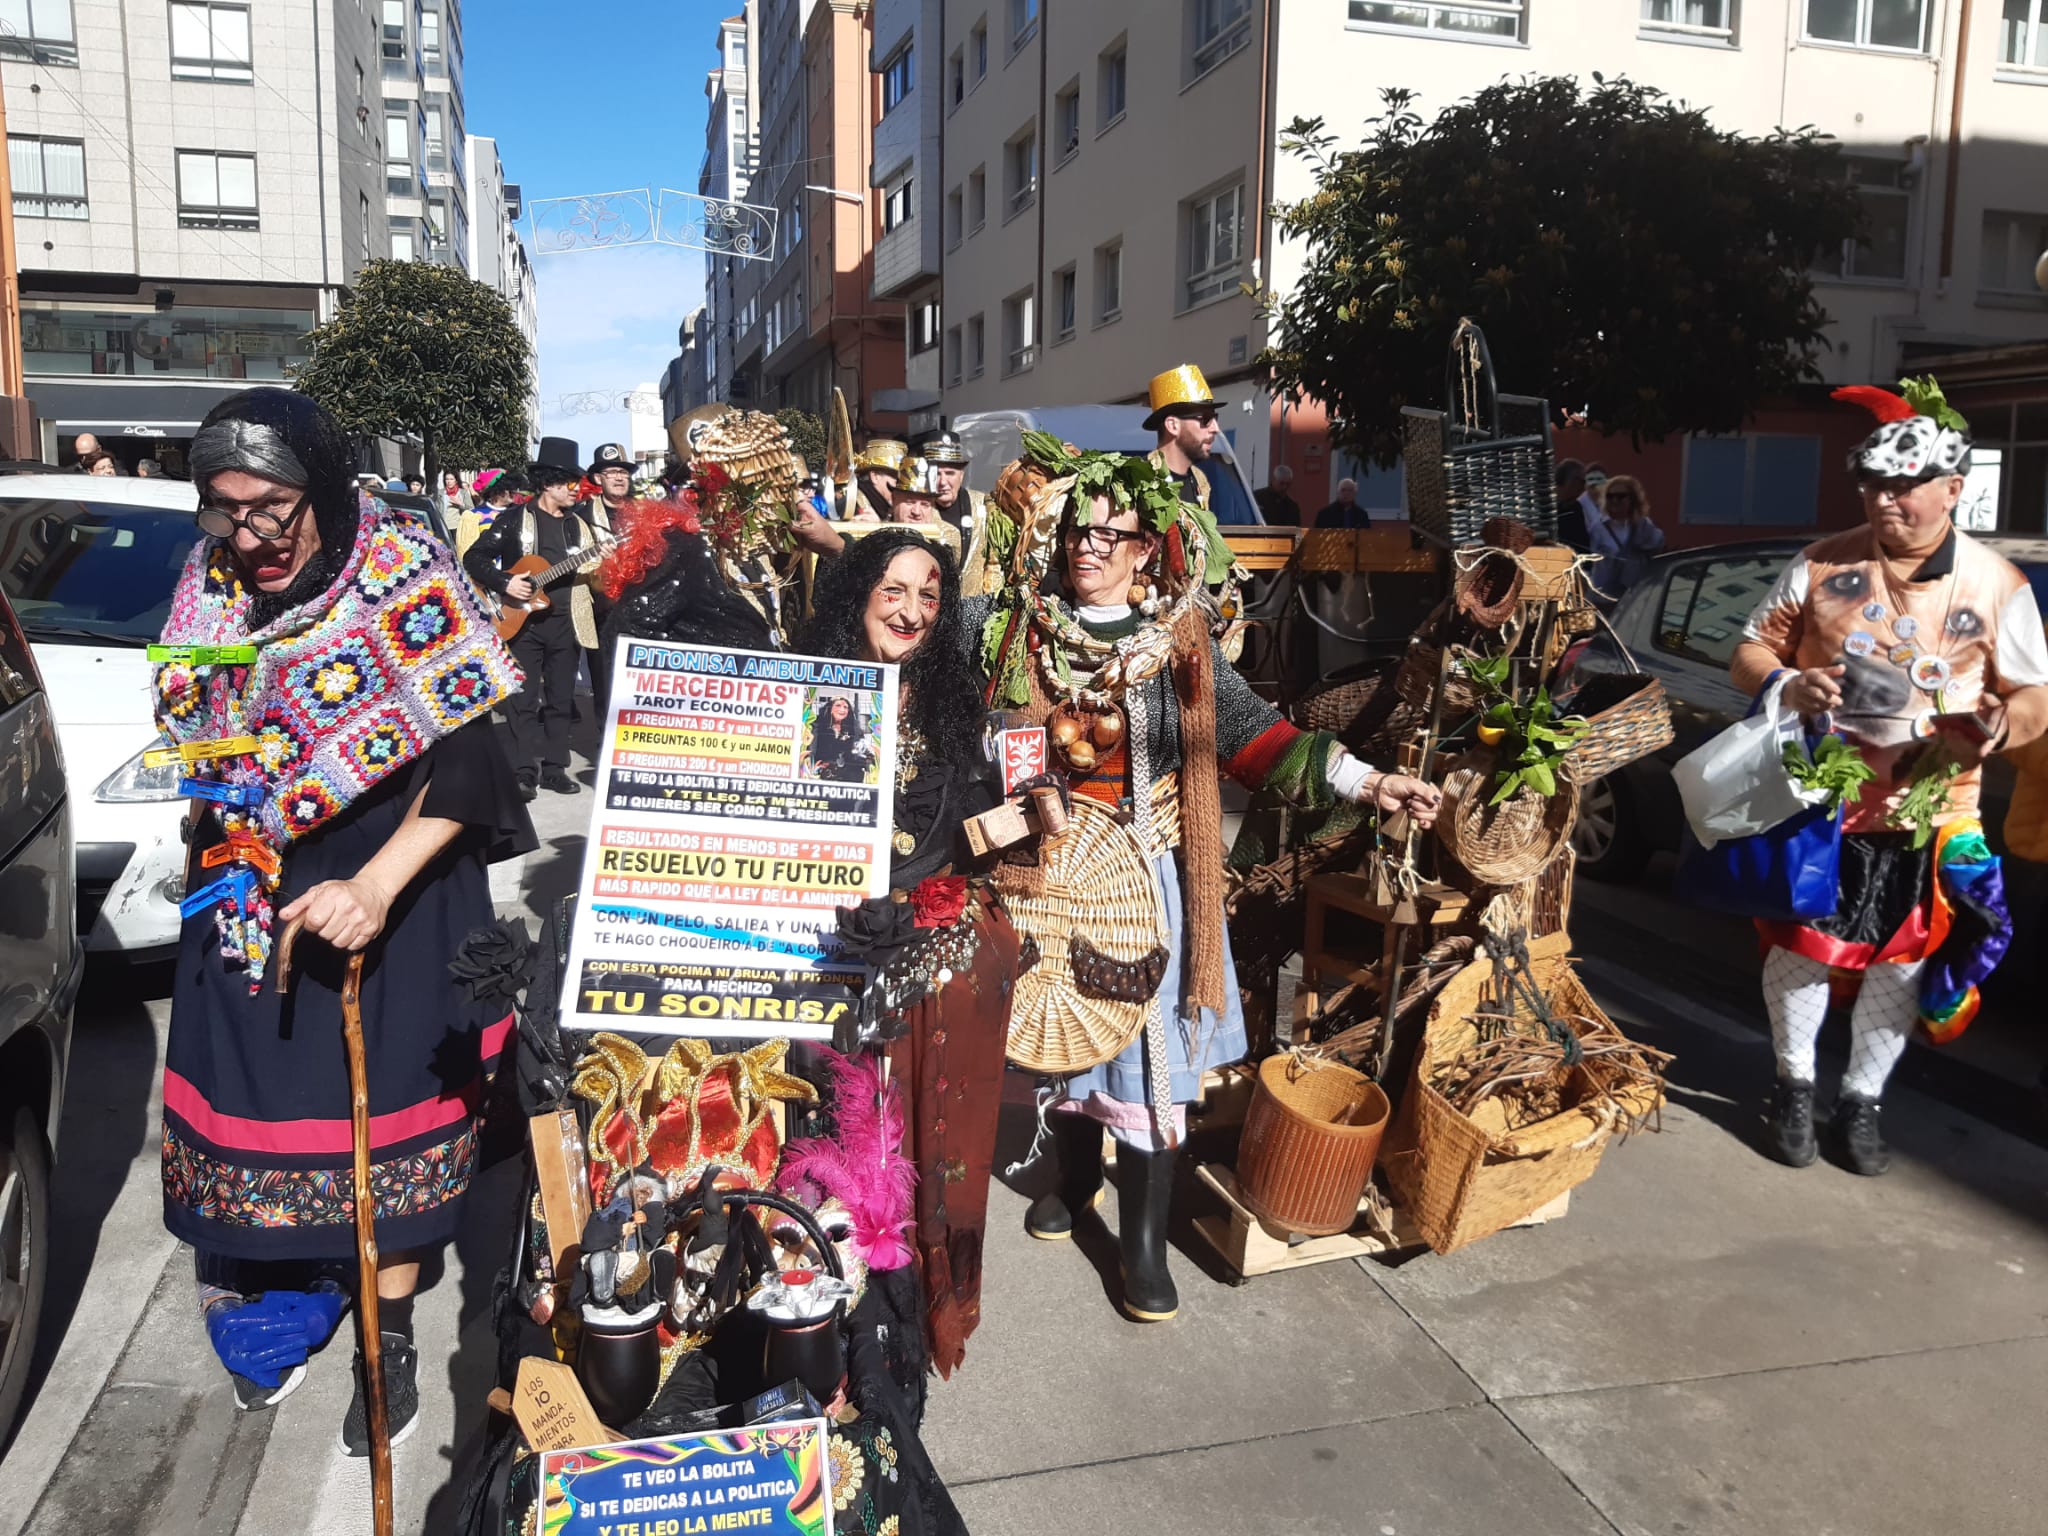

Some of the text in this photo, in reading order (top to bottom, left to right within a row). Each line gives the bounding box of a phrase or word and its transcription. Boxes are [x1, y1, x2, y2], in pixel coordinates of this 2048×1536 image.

[632, 646, 878, 687] PITONISA AMBULANTE
[626, 671, 799, 705] "MERCEDITAS"
[633, 695, 785, 719] TAROT ECONOMICO
[624, 713, 794, 739] 1 PREGUNTA 50 € y un LACON
[622, 731, 791, 756] 3 PREGUNTAS 100 € y un JAMON
[618, 752, 626, 764] 5
[628, 753, 687, 768] PREGUNTAS
[688, 758, 707, 771] 200
[717, 763, 724, 774] y
[725, 763, 737, 773] un
[739, 763, 790, 778] CHORIZON
[617, 771, 871, 801] TE VEO LA BOLITA SI TE DEDICAS A LA POLITICA
[663, 789, 829, 810] Y TE LEO LA MENTE
[613, 795, 871, 825] SI QUIERES SER COMO EL PRESIDENTE
[606, 829, 700, 851] RESULTADOS
[703, 834, 723, 851] EN
[726, 835, 777, 855] MENOS
[779, 841, 799, 857] DE
[834, 845, 867, 861] DIAS
[602, 849, 865, 887] RESUELVO TU FUTURO
[599, 878, 863, 908] MAS RAPIDO QUE LA LEY DE LA AMNISTIA
[596, 910, 630, 925] CON
[636, 912, 660, 926] UN
[663, 914, 710, 932] PELO,
[714, 917, 770, 932] SALIBA
[776, 920, 786, 933] Y
[790, 921, 822, 936] UNA
[594, 932, 611, 944] TE
[614, 932, 654, 947] HAGO
[659, 935, 753, 952] CHOQUEIRO/A
[757, 941, 775, 953] DE
[589, 961, 863, 985] CON ESTA POCIMA NI BRUJA, NI PITONISA
[664, 978, 774, 996] PARA HECHIZO
[585, 990, 849, 1023] TU SONRISA
[524, 1376, 544, 1397] LOS
[532, 1402, 568, 1431] MANDA-
[535, 1412, 576, 1448] MIENTOS
[552, 1433, 576, 1451] PARA
[623, 1460, 756, 1488] TE VEO LA BOLITA
[580, 1479, 796, 1519] SI TE DEDICAS A LA POLITICA
[599, 1508, 773, 1536] Y TE LEO LA MENTE
